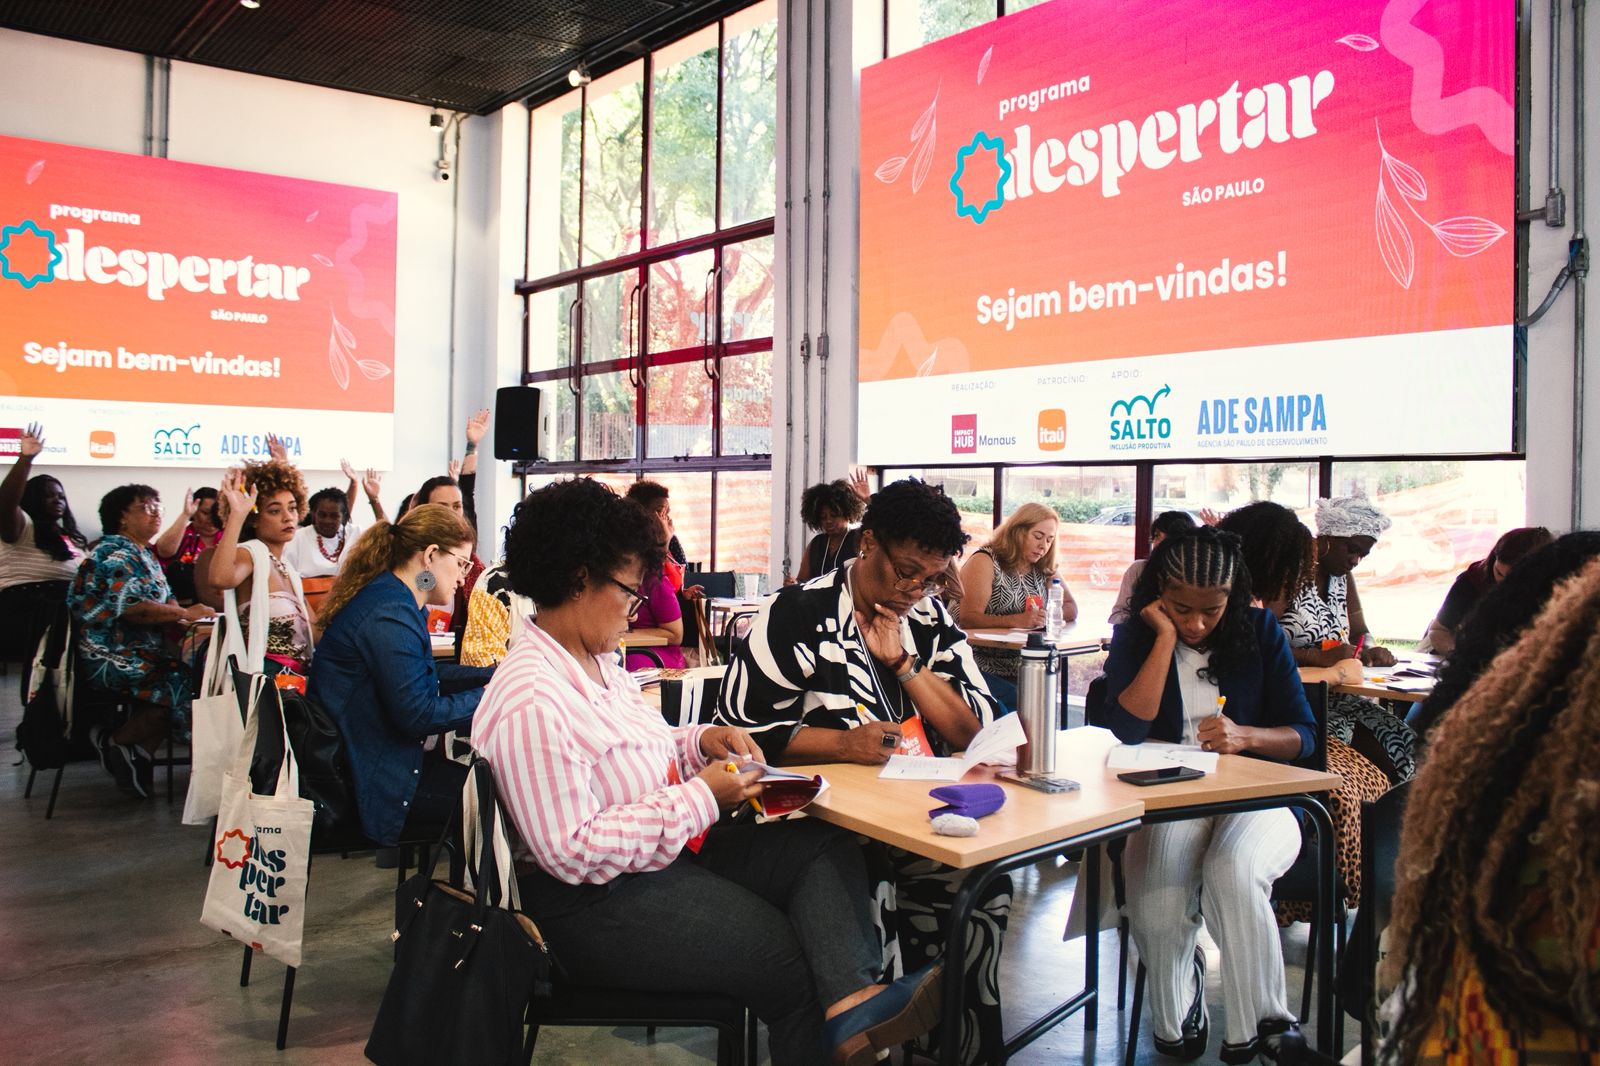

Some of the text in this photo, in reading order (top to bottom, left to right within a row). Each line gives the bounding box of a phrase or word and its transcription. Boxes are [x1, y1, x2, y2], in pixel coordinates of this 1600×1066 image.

[999, 75, 1091, 120] programa
[1000, 69, 1335, 202] despertar
[1182, 177, 1265, 206] SÃO PAULO
[50, 203, 141, 225] programa
[50, 228, 311, 301] despertar
[976, 250, 1287, 331] Sejam bem-vindas!
[210, 308, 269, 324] SÃO PAULO
[23, 341, 281, 378] Sejam bem-vindas!
[1197, 393, 1327, 435] ADE SAMPA
[953, 434, 1017, 449] HUB Manaus
[954, 428, 975, 436] IMPACT
[1039, 426, 1065, 444] itaú
[1110, 417, 1171, 441] SALTO
[1236, 438, 1256, 447] PAULO
[1257, 438, 1266, 446] DE
[1266, 436, 1328, 446] DESENVOLVIMENTO
[154, 441, 201, 455] SALTO
[221, 434, 301, 456] ADE SAPA
[239, 860, 286, 898] per
[243, 892, 290, 925] tar
